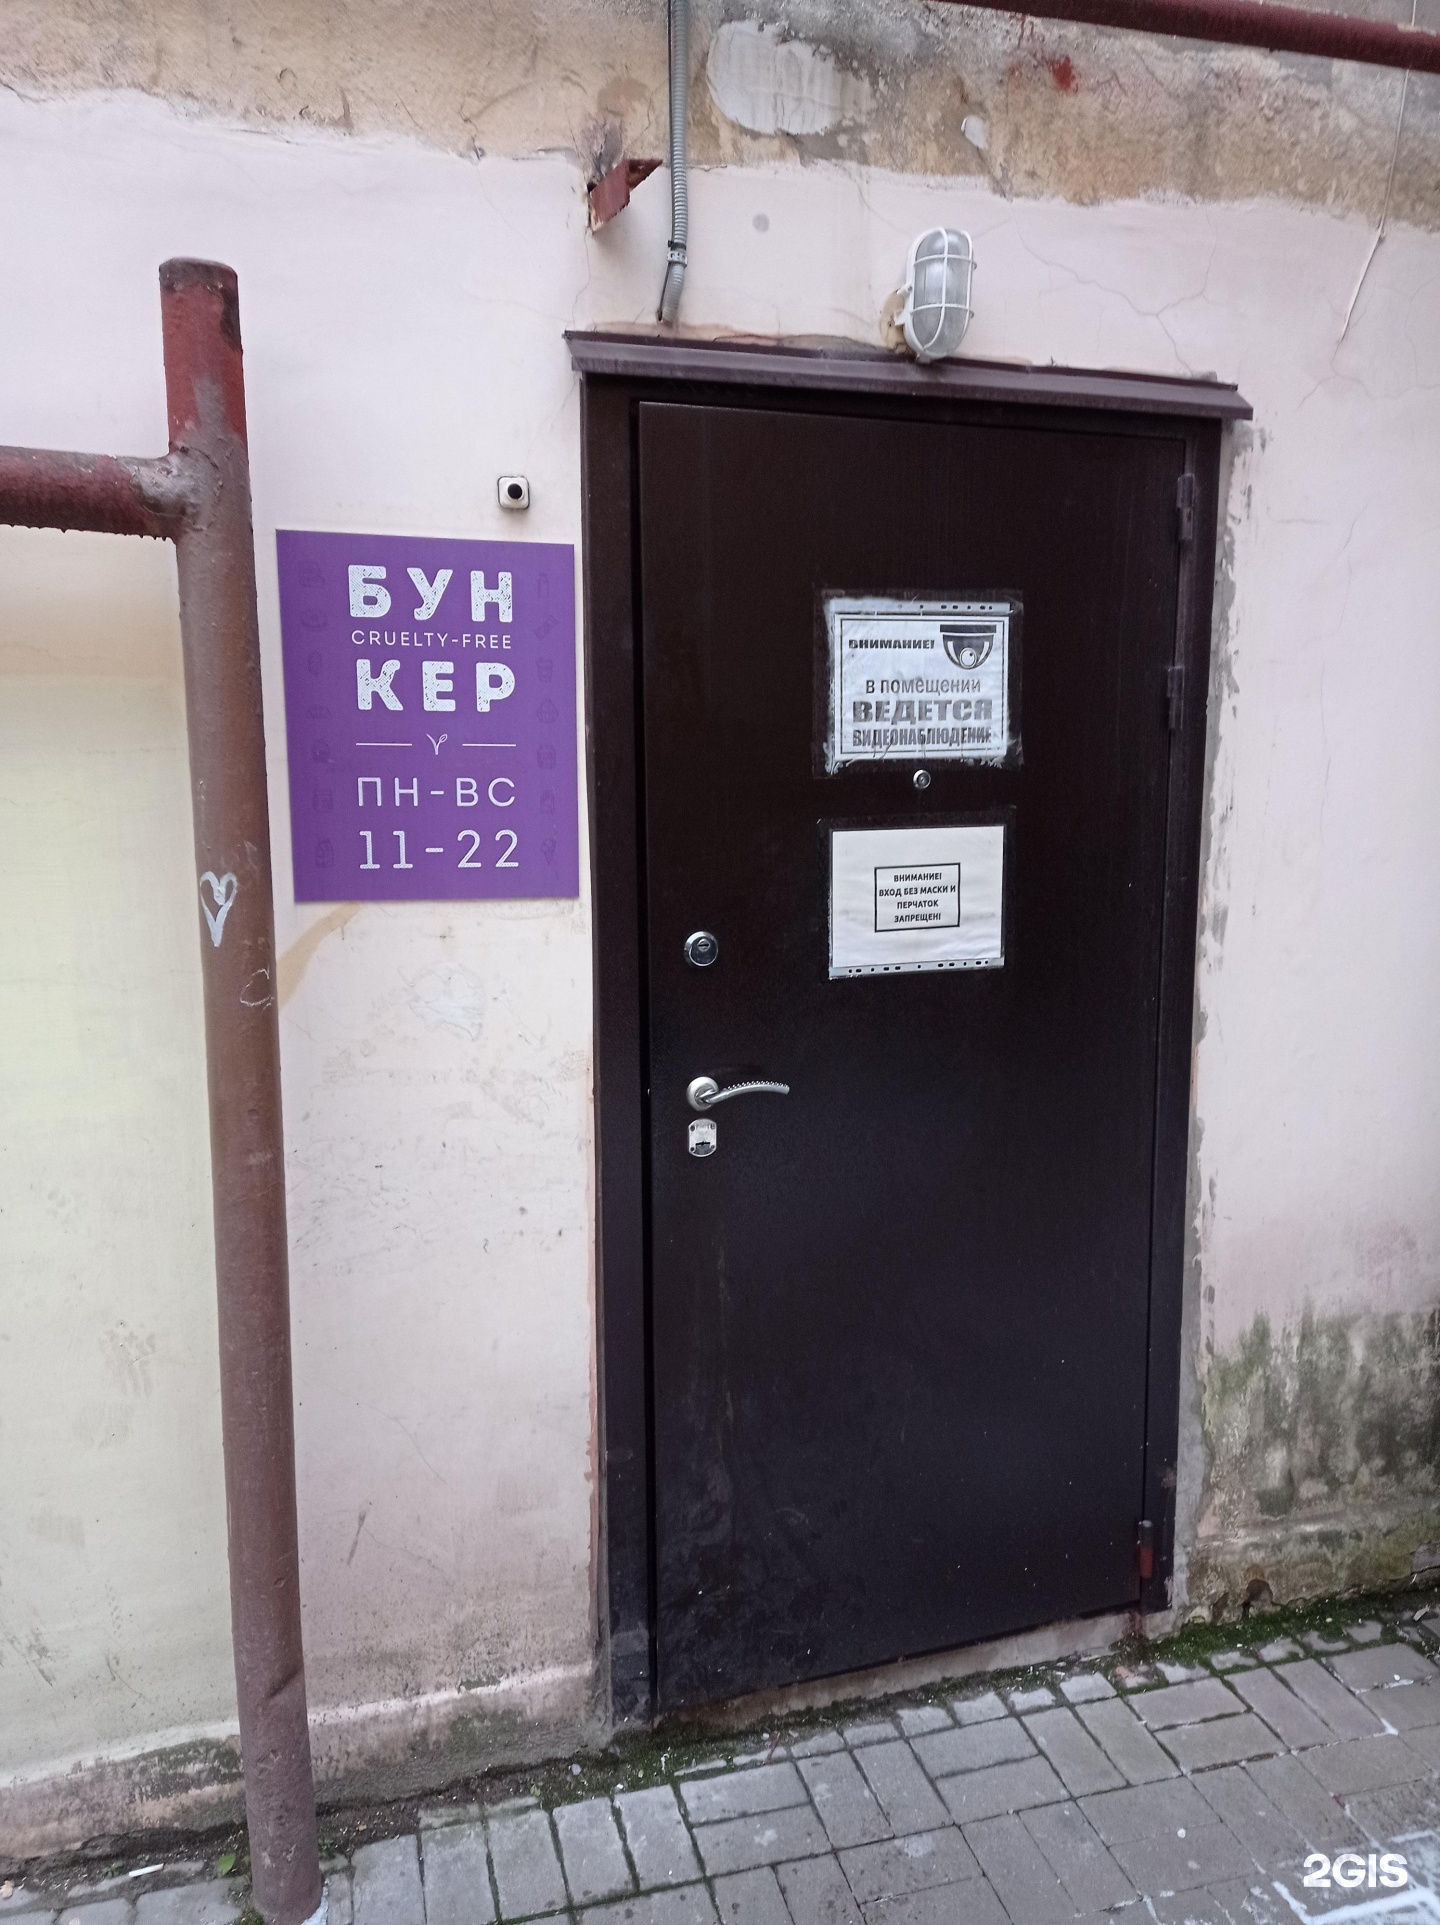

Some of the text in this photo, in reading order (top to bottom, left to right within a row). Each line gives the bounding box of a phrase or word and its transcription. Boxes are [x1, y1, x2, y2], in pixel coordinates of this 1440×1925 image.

[348, 564, 513, 623] БУН
[351, 630, 512, 649] CRUELTY-FREE
[848, 639, 935, 650] ВНИМАНИЕ!
[356, 658, 516, 712] КЕР
[852, 700, 993, 725] ВЕДЕТСЯ
[852, 727, 992, 748] ВИДЕОНАБЛЮДЕНИЕ
[357, 777, 516, 807] ПН-ВС
[359, 829, 520, 869] 11-22
[893, 872, 942, 882] ВНИМАНИЕ!
[879, 885, 956, 897] ВХОД БЕЗ МАСКИ И
[896, 900, 939, 909] ПЕРЧАТОК
[894, 913, 942, 923] ЗАПРЕЩЕН!
